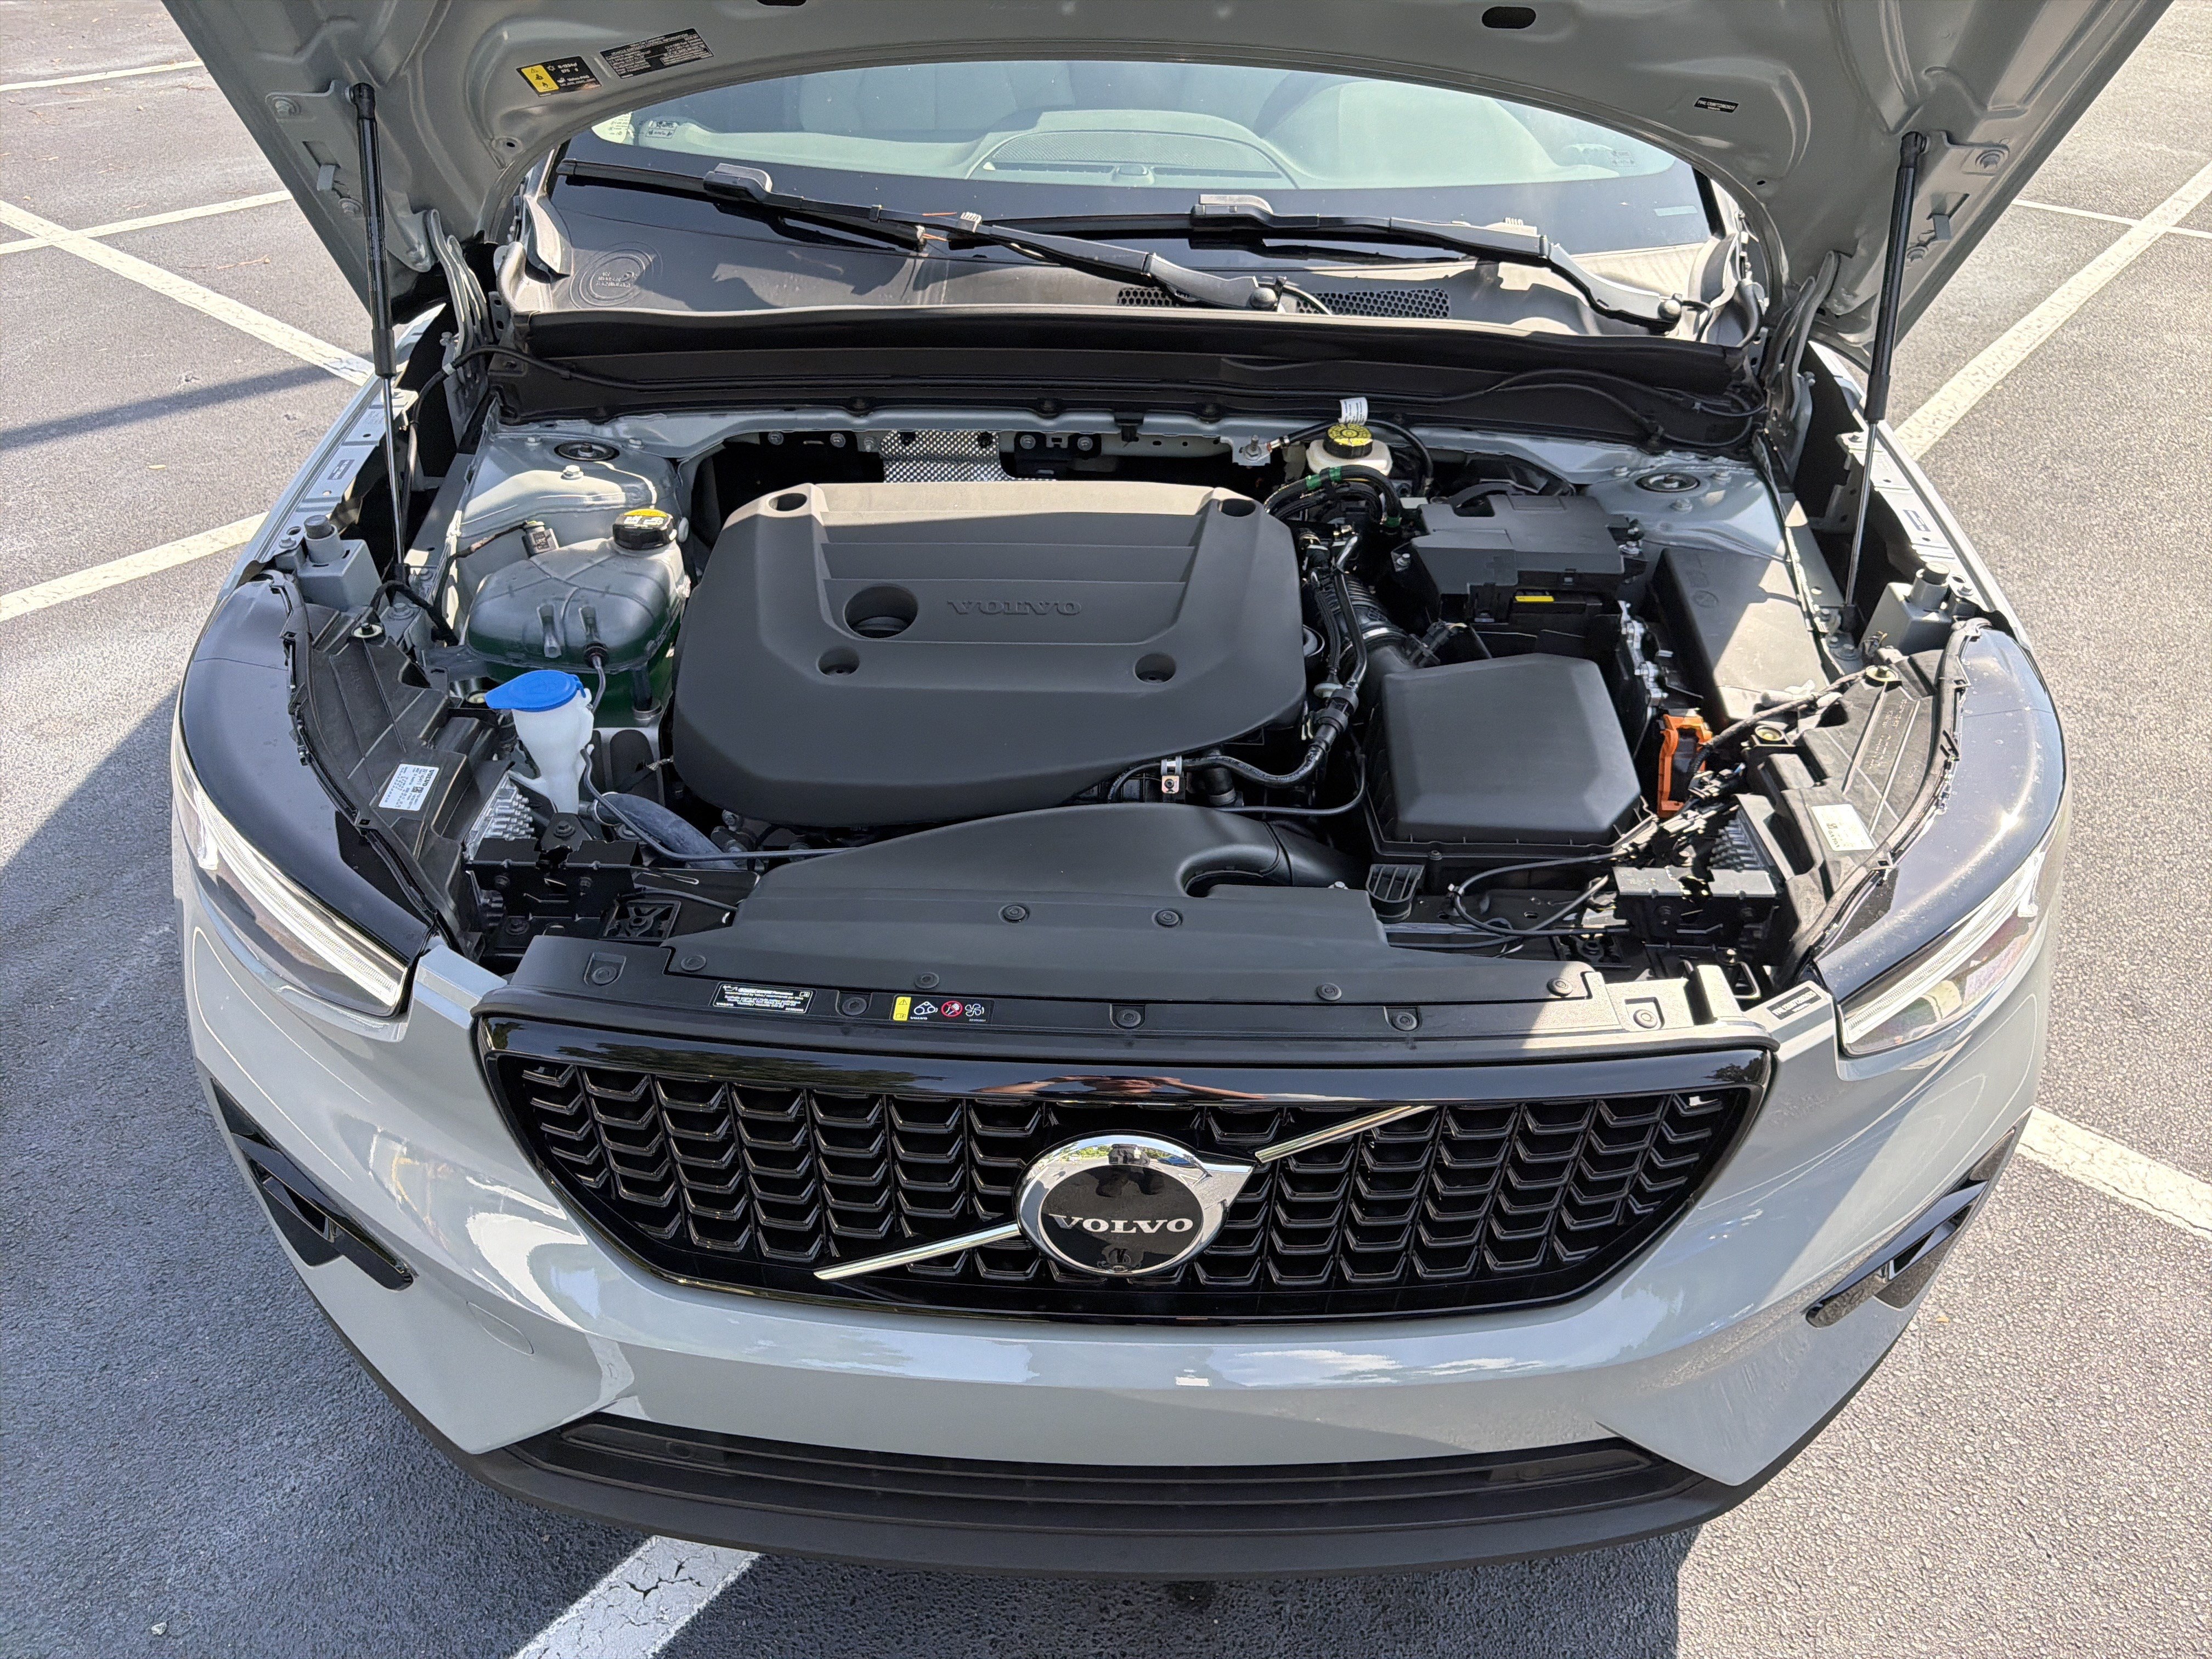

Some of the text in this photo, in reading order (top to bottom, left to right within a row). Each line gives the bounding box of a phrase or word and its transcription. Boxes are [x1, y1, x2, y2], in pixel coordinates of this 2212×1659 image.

[947, 600, 1082, 616] VOLVO
[422, 769, 435, 787] VOLVO
[1048, 1214, 1194, 1234] VOLVO
